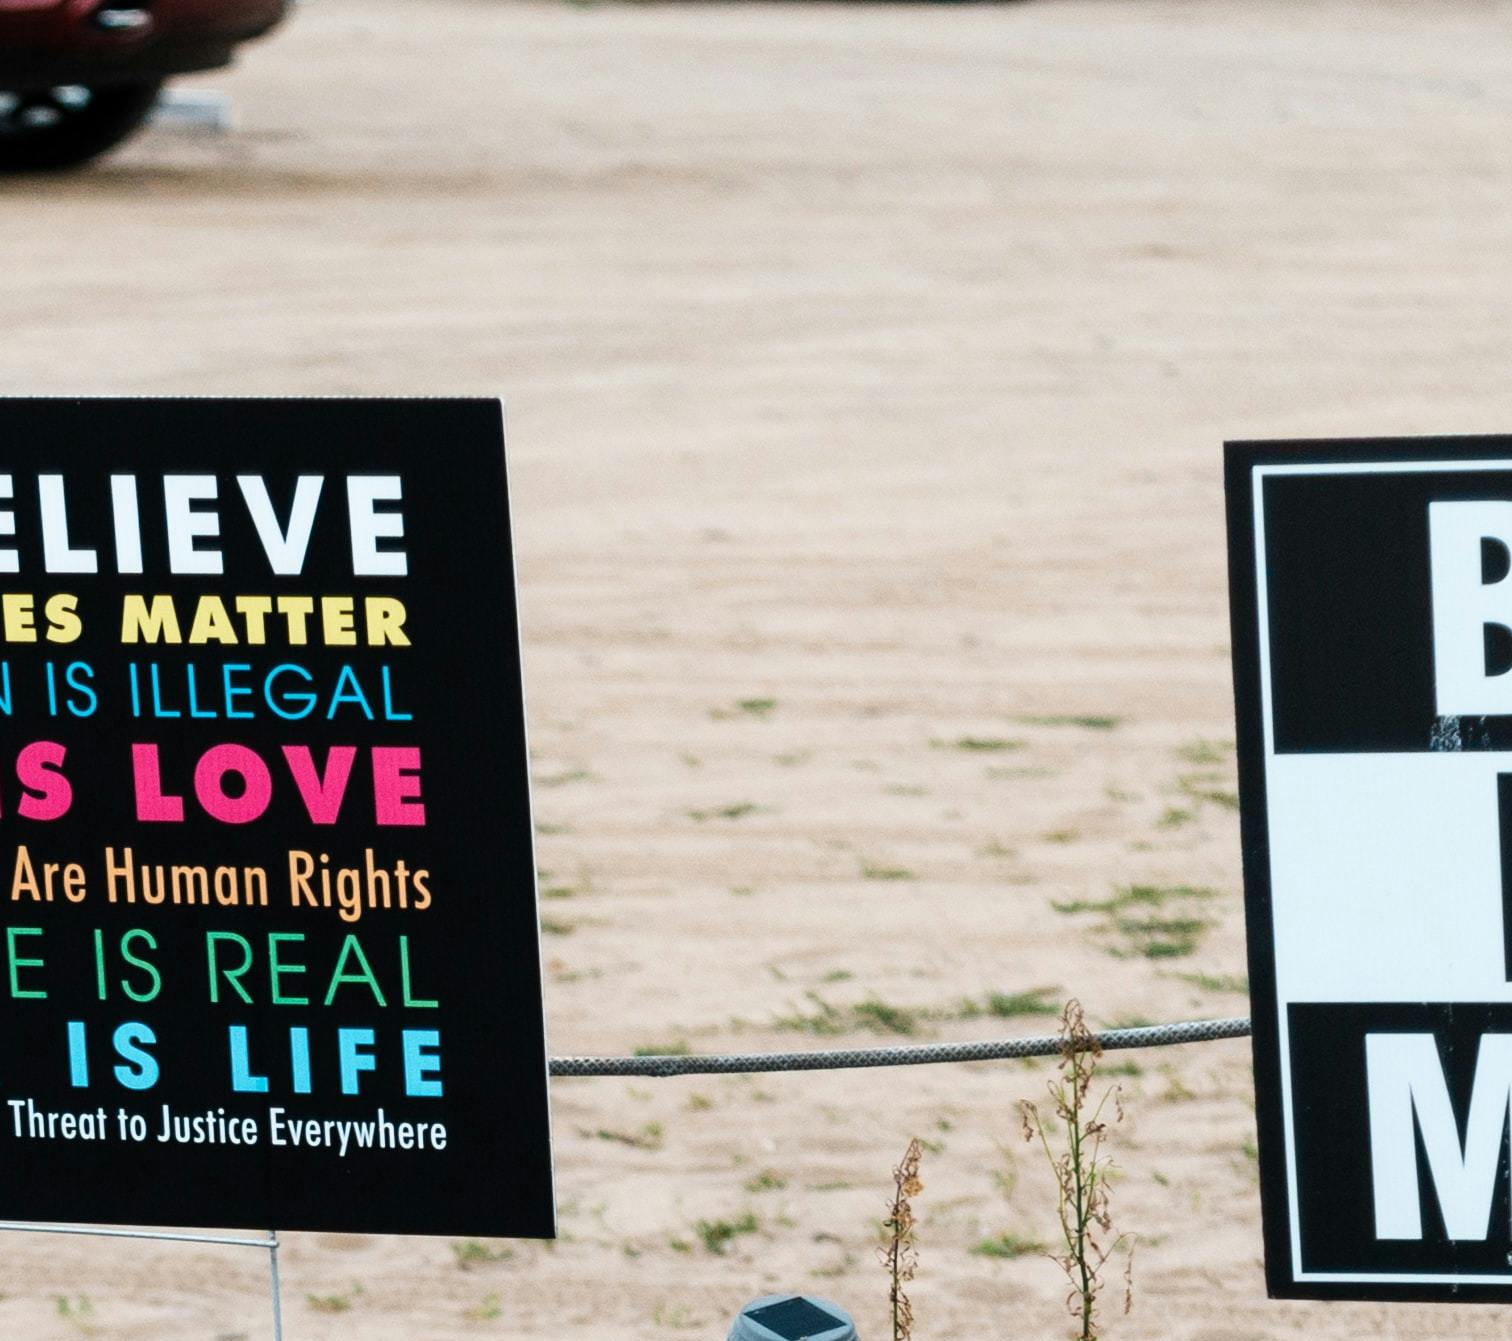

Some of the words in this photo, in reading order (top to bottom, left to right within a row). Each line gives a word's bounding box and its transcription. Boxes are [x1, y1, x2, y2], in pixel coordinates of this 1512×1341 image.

[120, 594, 412, 647] MATTER
[46, 661, 98, 718] IS
[129, 662, 413, 721] ILLEGAL
[131, 743, 426, 827] LOVE
[11, 845, 86, 903] Are
[105, 846, 268, 906] Human
[288, 847, 432, 923] Rights
[94, 928, 162, 1003] IS
[206, 931, 439, 1008] REAL
[67, 1021, 160, 1091] IS
[228, 1025, 444, 1098] LIFE
[7, 1097, 108, 1140] Threat
[117, 1108, 147, 1142] to
[156, 1104, 258, 1145] Justice
[269, 1107, 447, 1157] Everywhere
